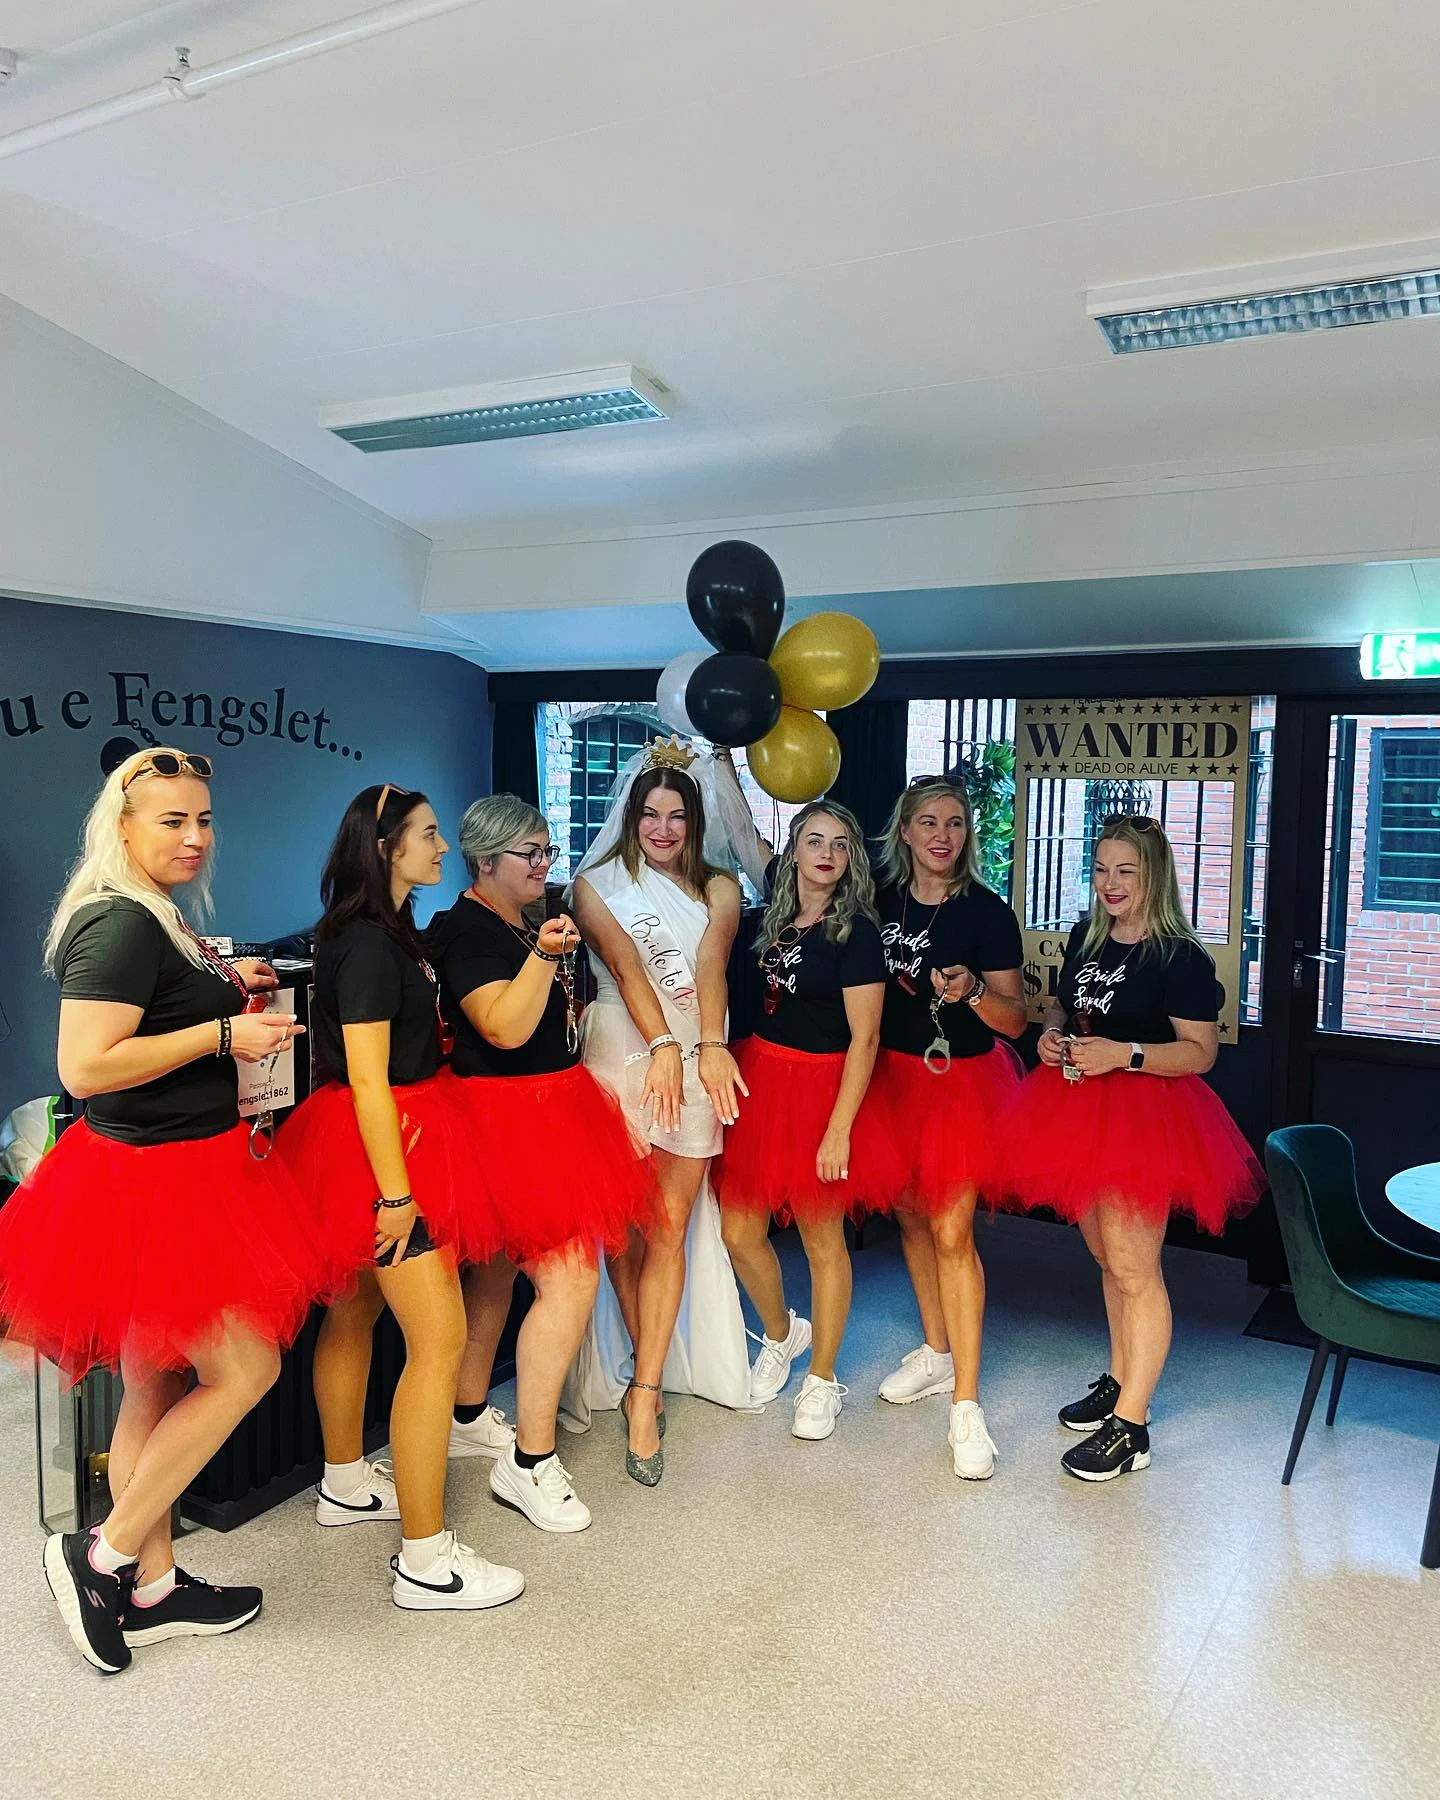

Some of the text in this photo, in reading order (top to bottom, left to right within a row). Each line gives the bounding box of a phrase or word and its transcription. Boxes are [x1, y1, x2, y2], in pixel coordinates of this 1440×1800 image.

[61, 689, 92, 729] e
[108, 671, 362, 761] Fengslet...
[1024, 722, 1238, 759] WANTED
[1075, 762, 1179, 774] DEAD OR ALIVE
[630, 913, 681, 970] Bride
[660, 968, 683, 987] to
[880, 922, 932, 952] Bride
[1075, 961, 1126, 986] Bride
